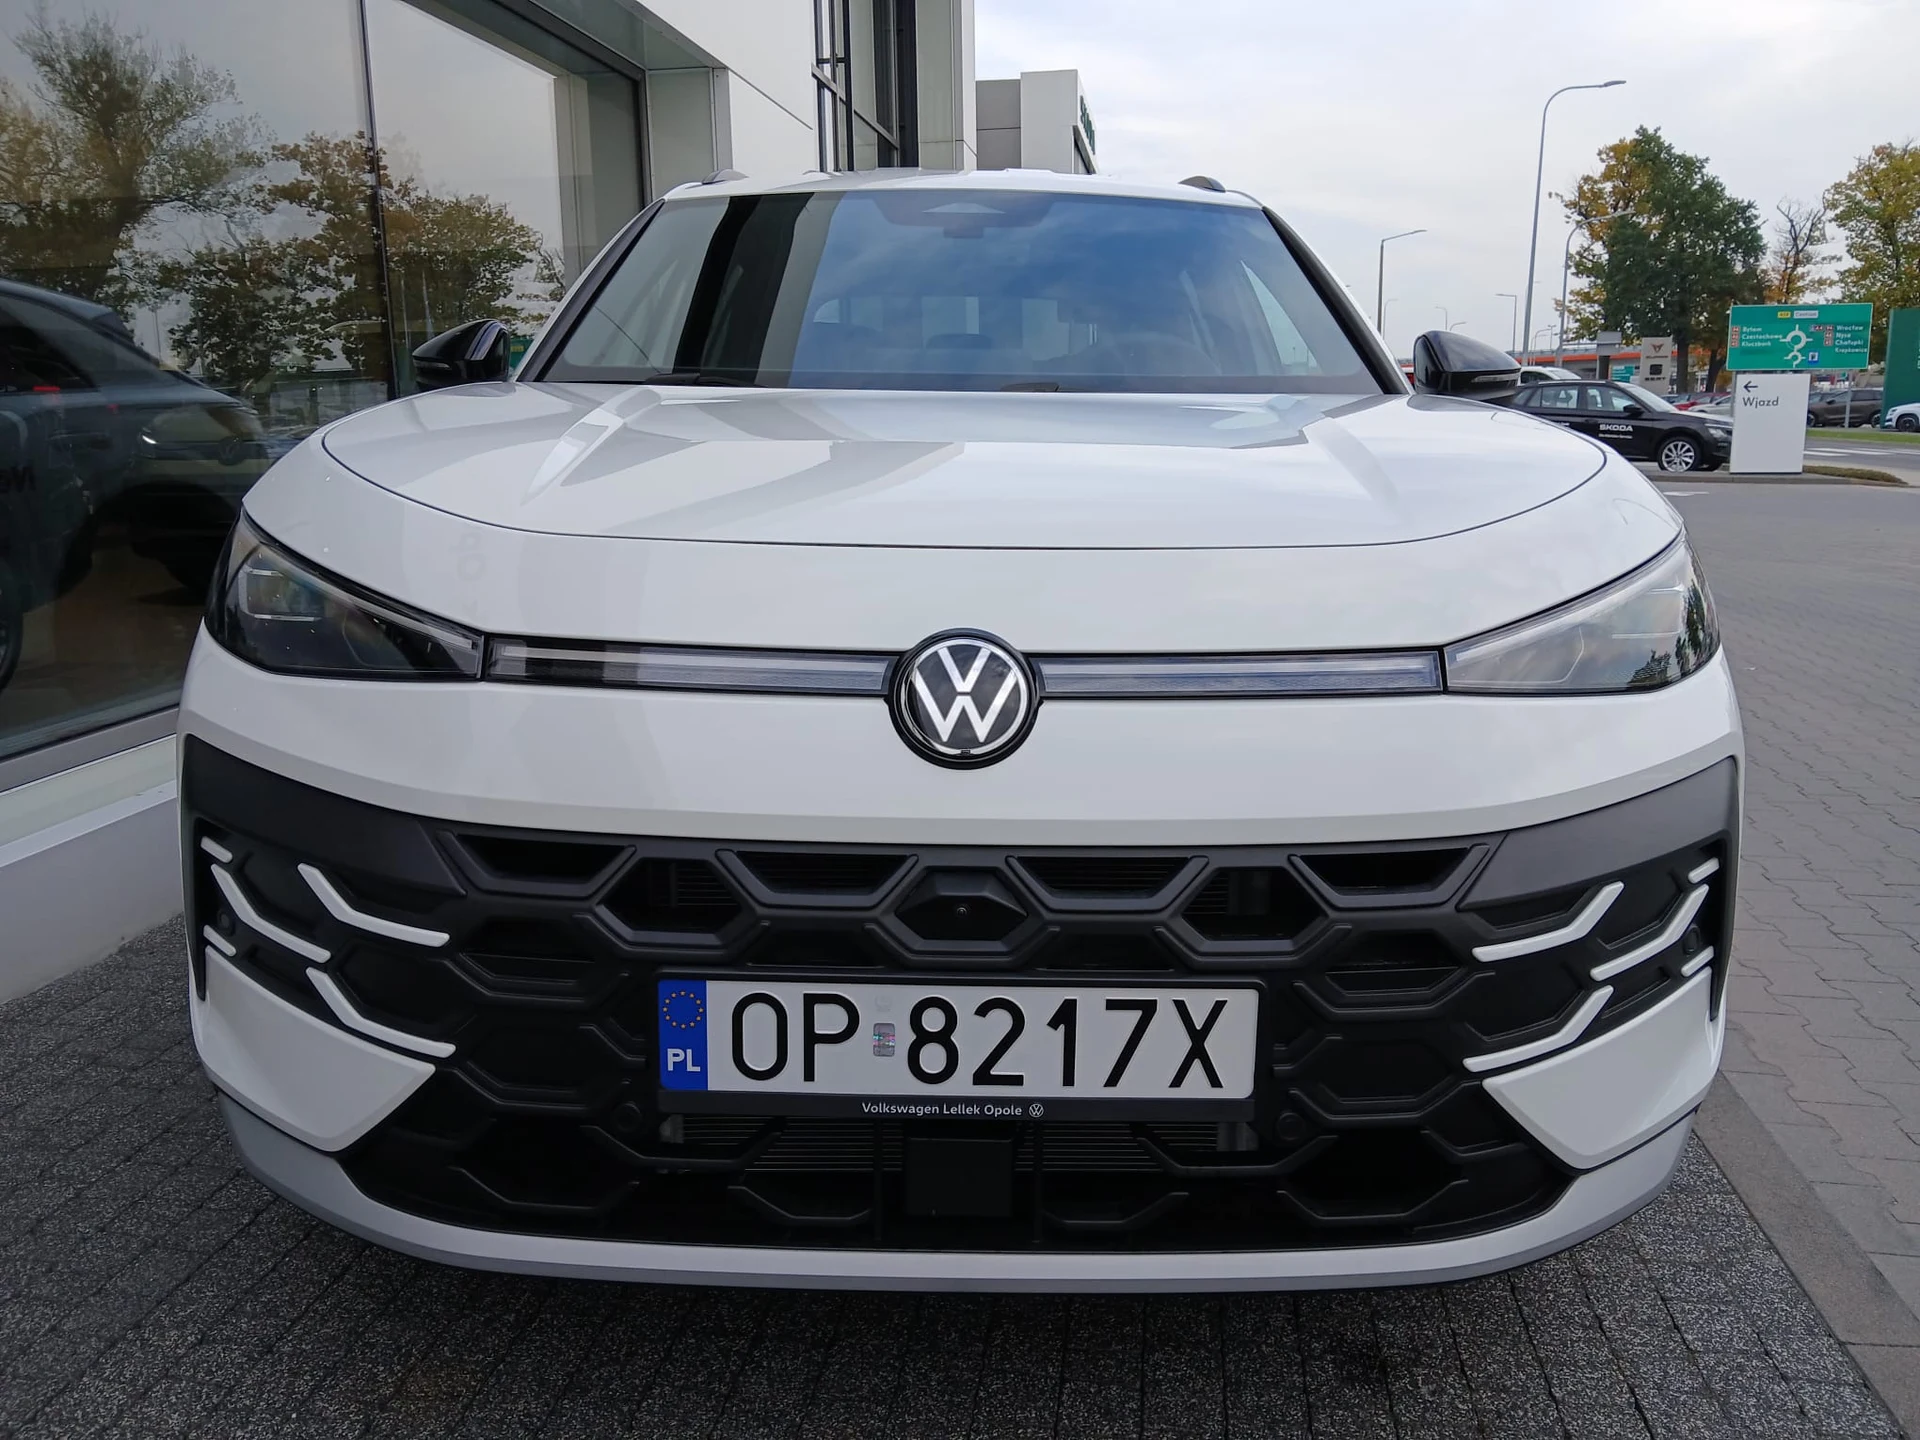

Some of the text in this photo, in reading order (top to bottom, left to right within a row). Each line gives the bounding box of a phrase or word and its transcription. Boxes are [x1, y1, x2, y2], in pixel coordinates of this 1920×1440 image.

[1742, 397, 1779, 409] Wjazd
[732, 992, 1228, 1089] OP 8217X
[667, 1048, 701, 1072] PL
[861, 1102, 940, 1116] Volkswagen
[943, 1103, 981, 1115] Lellek
[984, 1104, 1022, 1117] Opole
